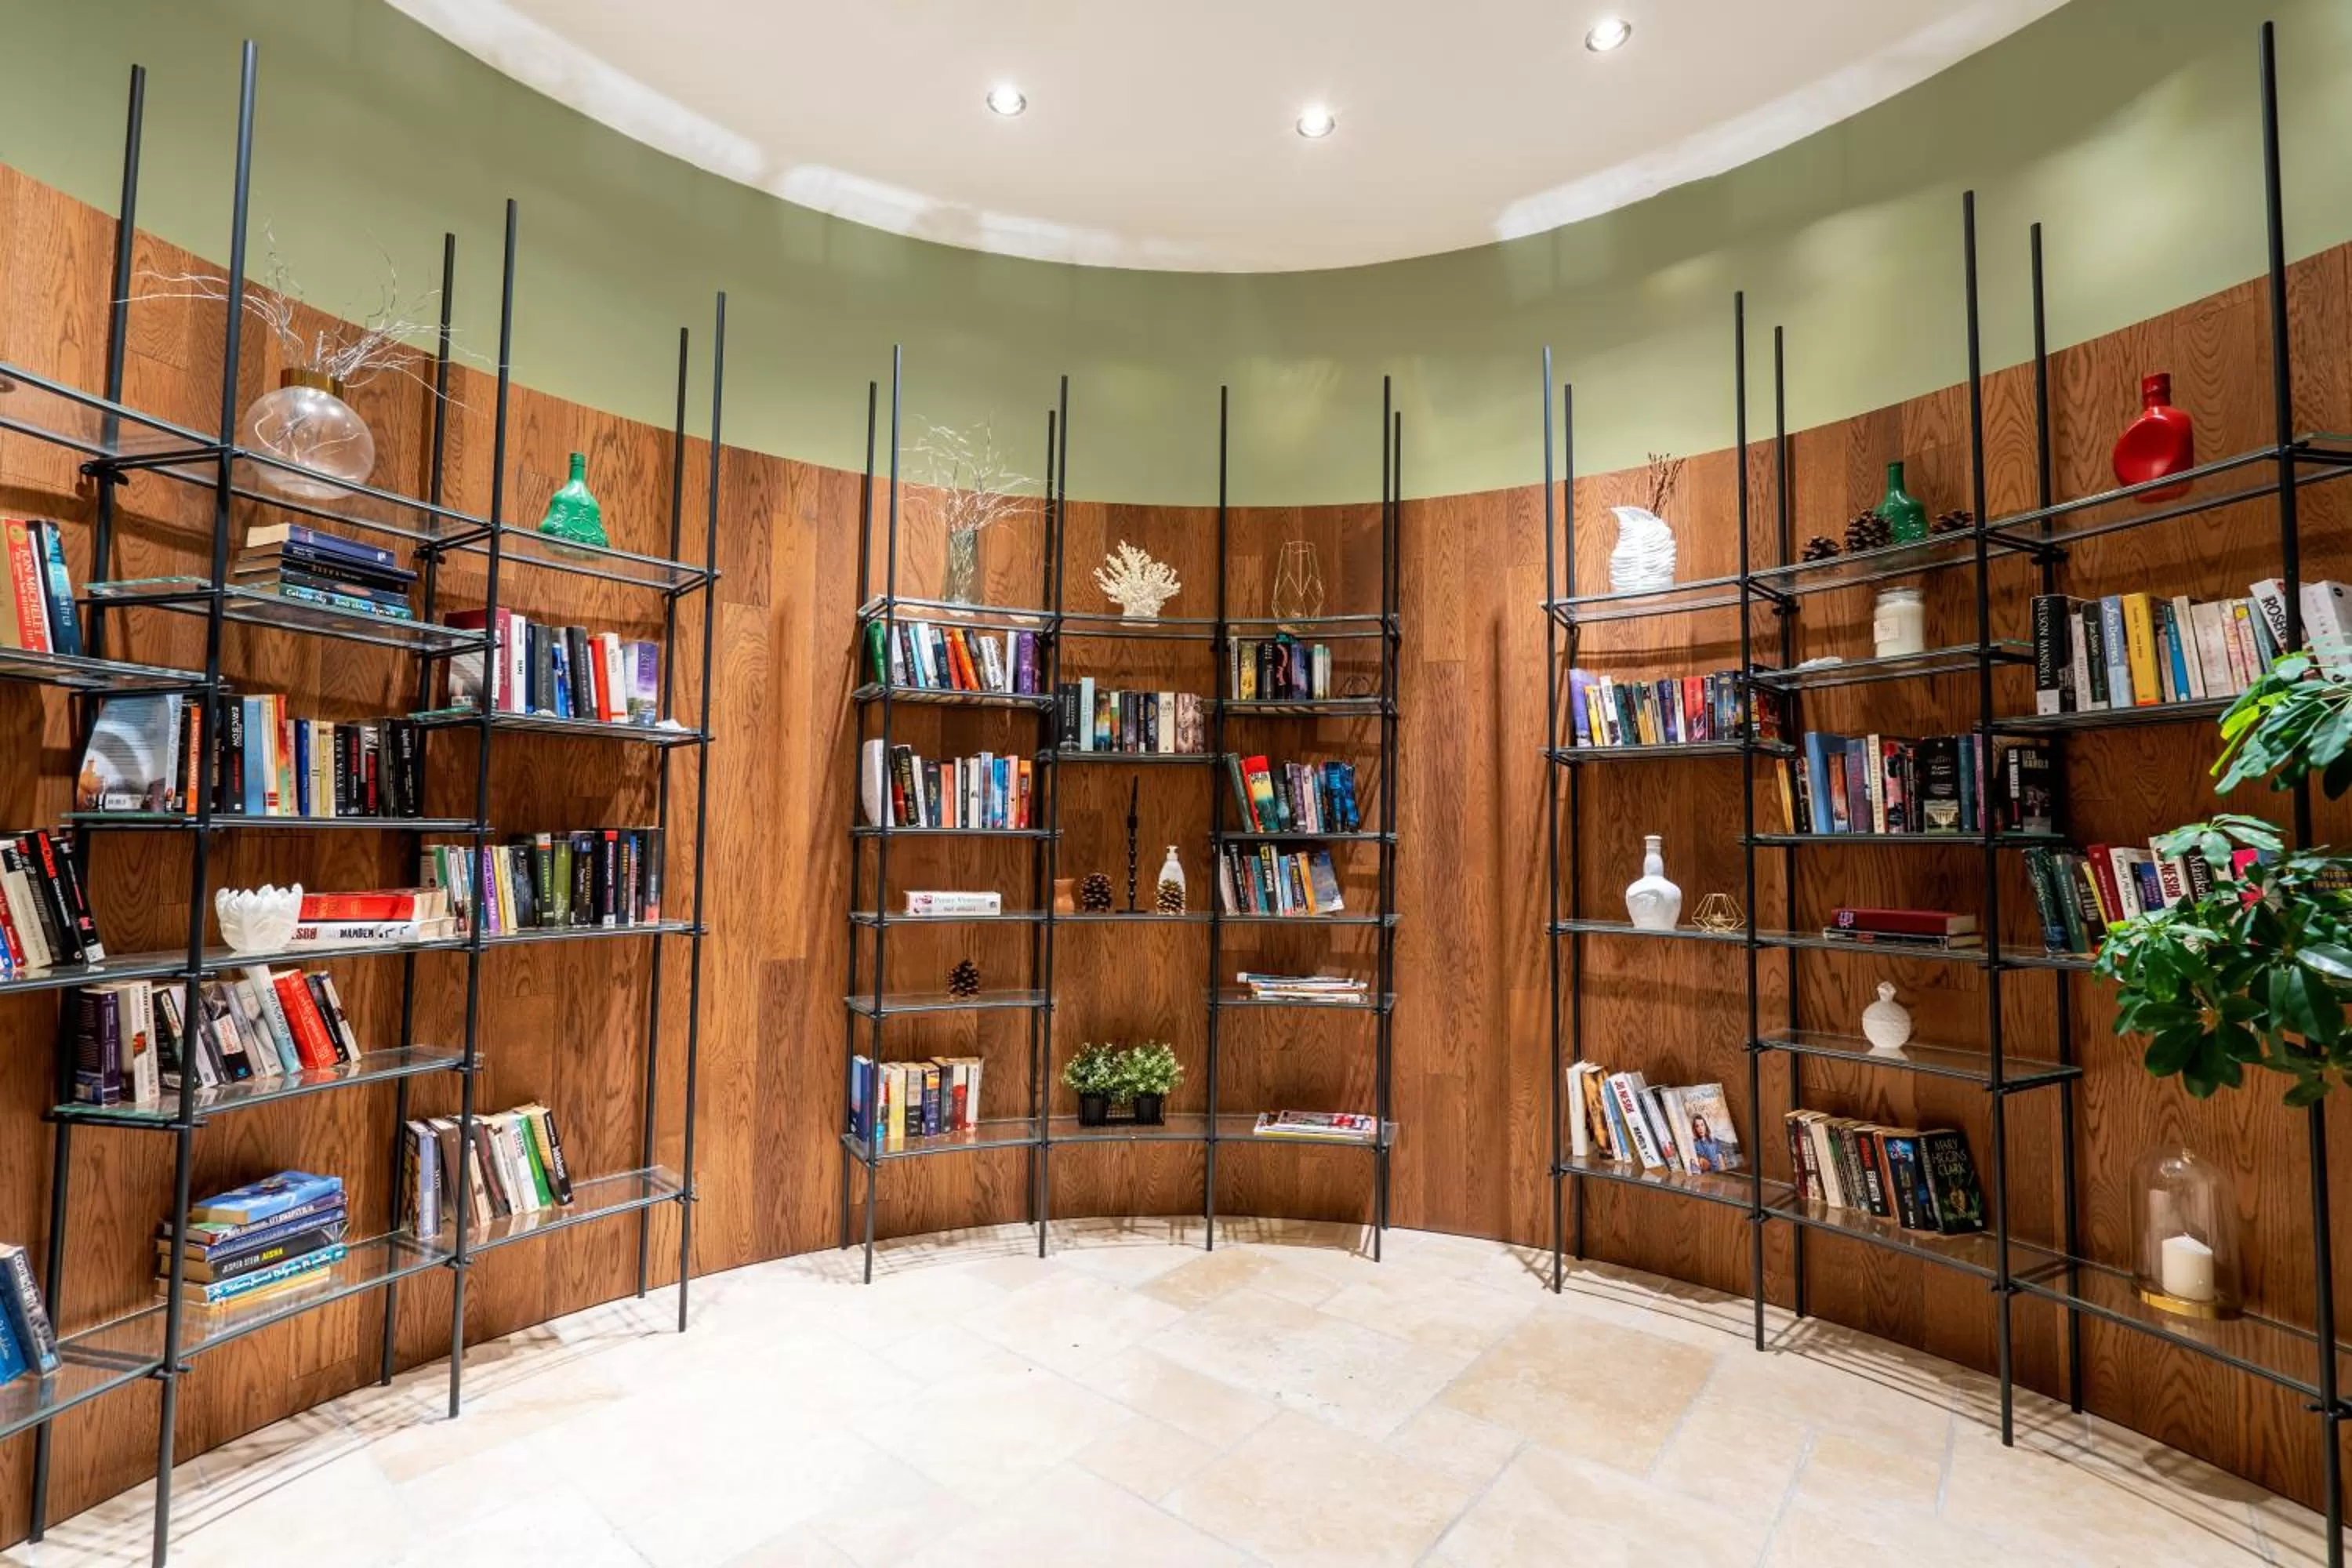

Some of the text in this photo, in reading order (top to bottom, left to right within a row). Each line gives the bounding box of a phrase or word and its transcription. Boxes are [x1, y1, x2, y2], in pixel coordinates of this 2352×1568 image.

[19, 547, 33, 573] JON
[27, 576, 44, 637] MICHELET
[2038, 598, 2051, 687] NELSON MANDELA
[2161, 862, 2182, 898] NESBØ
[2189, 854, 2206, 900] Mankel
[291, 927, 318, 940] SBØ
[1619, 1091, 1635, 1114] NESBØ
